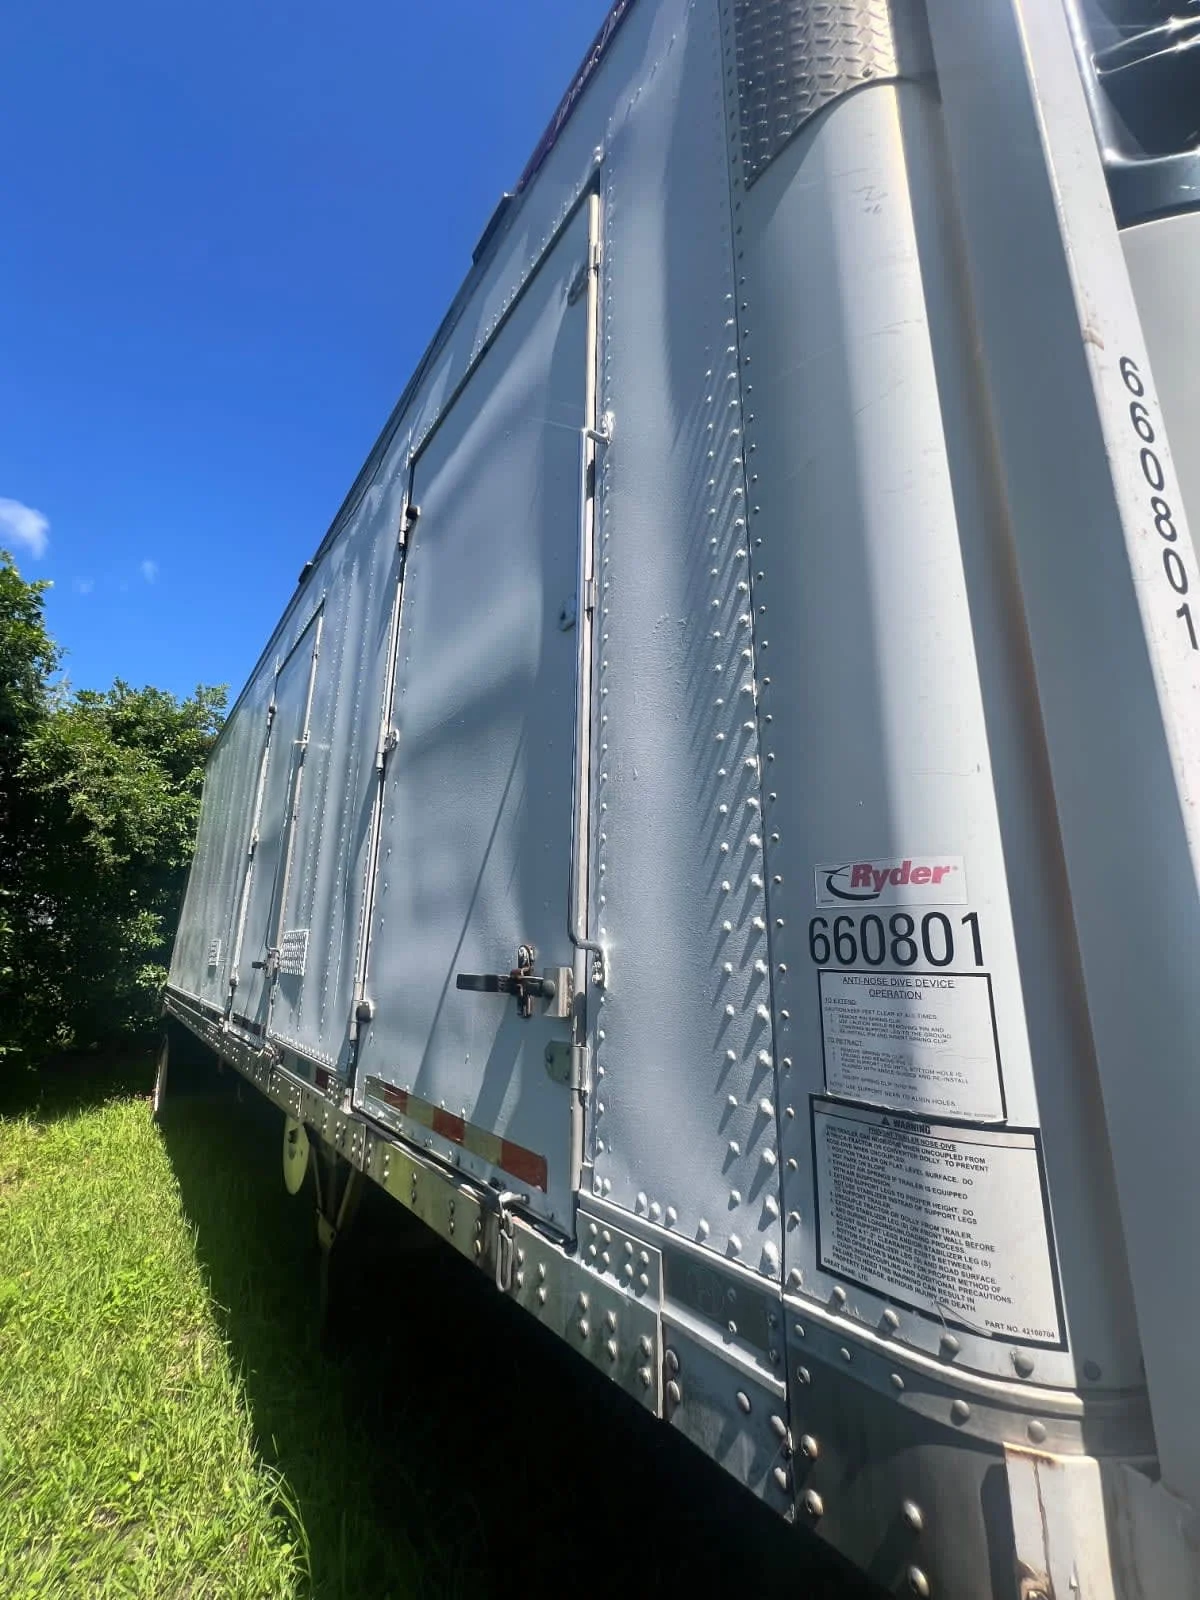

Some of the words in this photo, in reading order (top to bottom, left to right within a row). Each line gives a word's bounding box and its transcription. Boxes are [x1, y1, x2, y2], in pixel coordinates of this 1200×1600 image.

[1119, 356, 1199, 650] 660801
[851, 861, 950, 892] Ryder
[809, 912, 983, 966] 660801
[842, 976, 888, 986] ANTI-NOSE
[890, 978, 912, 987] DIVE
[915, 979, 956, 988] DEVICE
[868, 989, 922, 1000] OPERATION
[894, 1119, 931, 1134] WARNING
[920, 1139, 956, 1150] NOSE-DIVE
[920, 1147, 963, 1160] UNCOUPLED
[964, 1155, 986, 1164] FROM
[919, 1154, 939, 1163] DOLLY
[955, 1161, 988, 1172] PREVENT
[932, 1187, 968, 1200] EQUIPPED
[924, 1208, 956, 1220] SUPPORT
[957, 1215, 977, 1225] LEGS
[943, 1234, 963, 1246] WALL
[964, 1241, 995, 1253] BEFORE
[964, 1255, 979, 1265] LEG
[957, 1278, 990, 1292] METHOD
[950, 1300, 976, 1312] DEATH
[984, 1320, 1005, 1331] PART
